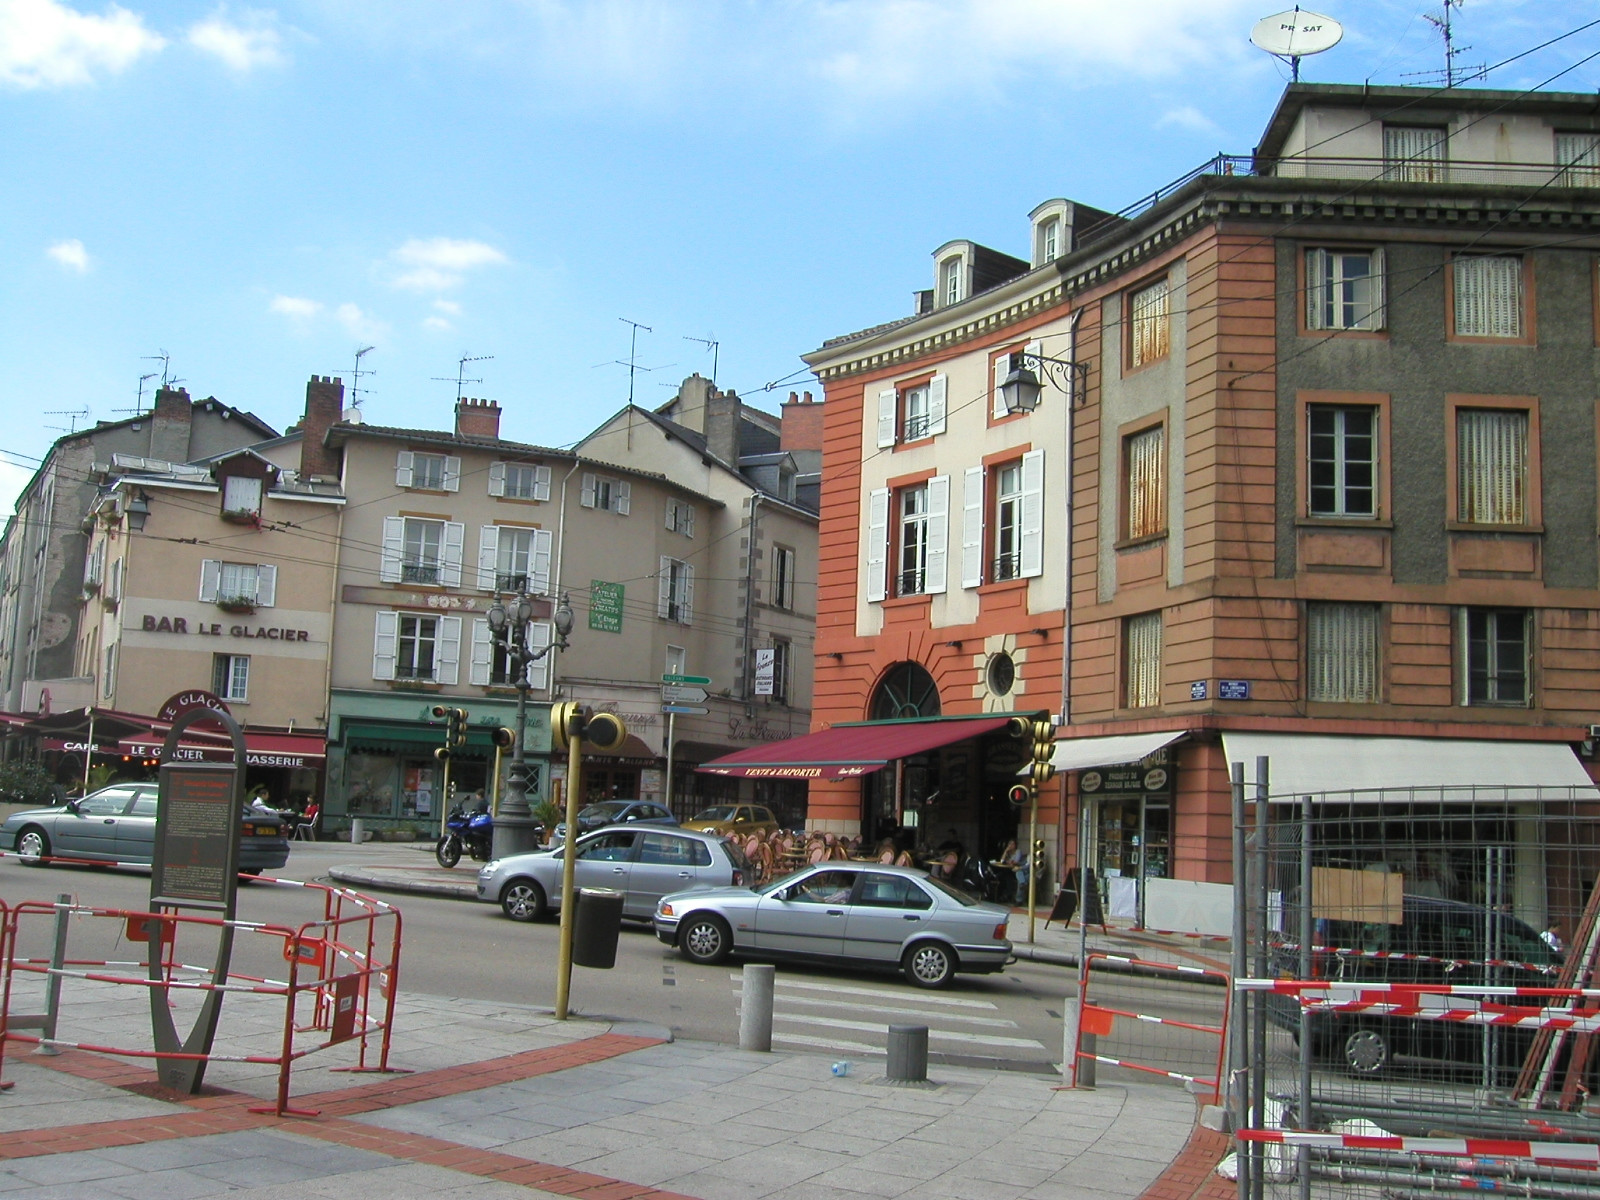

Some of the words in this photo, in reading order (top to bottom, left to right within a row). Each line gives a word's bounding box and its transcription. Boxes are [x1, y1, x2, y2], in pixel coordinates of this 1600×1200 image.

[1302, 25, 1323, 33] SAT
[597, 590, 618, 599] ATELIER
[142, 614, 187, 634] BAR
[198, 622, 221, 635] LE
[230, 625, 308, 642] GLACIER
[179, 693, 223, 713] GLACI
[131, 746, 146, 755] LE
[152, 747, 204, 760] GCIER
[233, 754, 304, 766] RASSERIE
[744, 768, 769, 776] VENTE
[776, 768, 822, 777] EMPORTER
